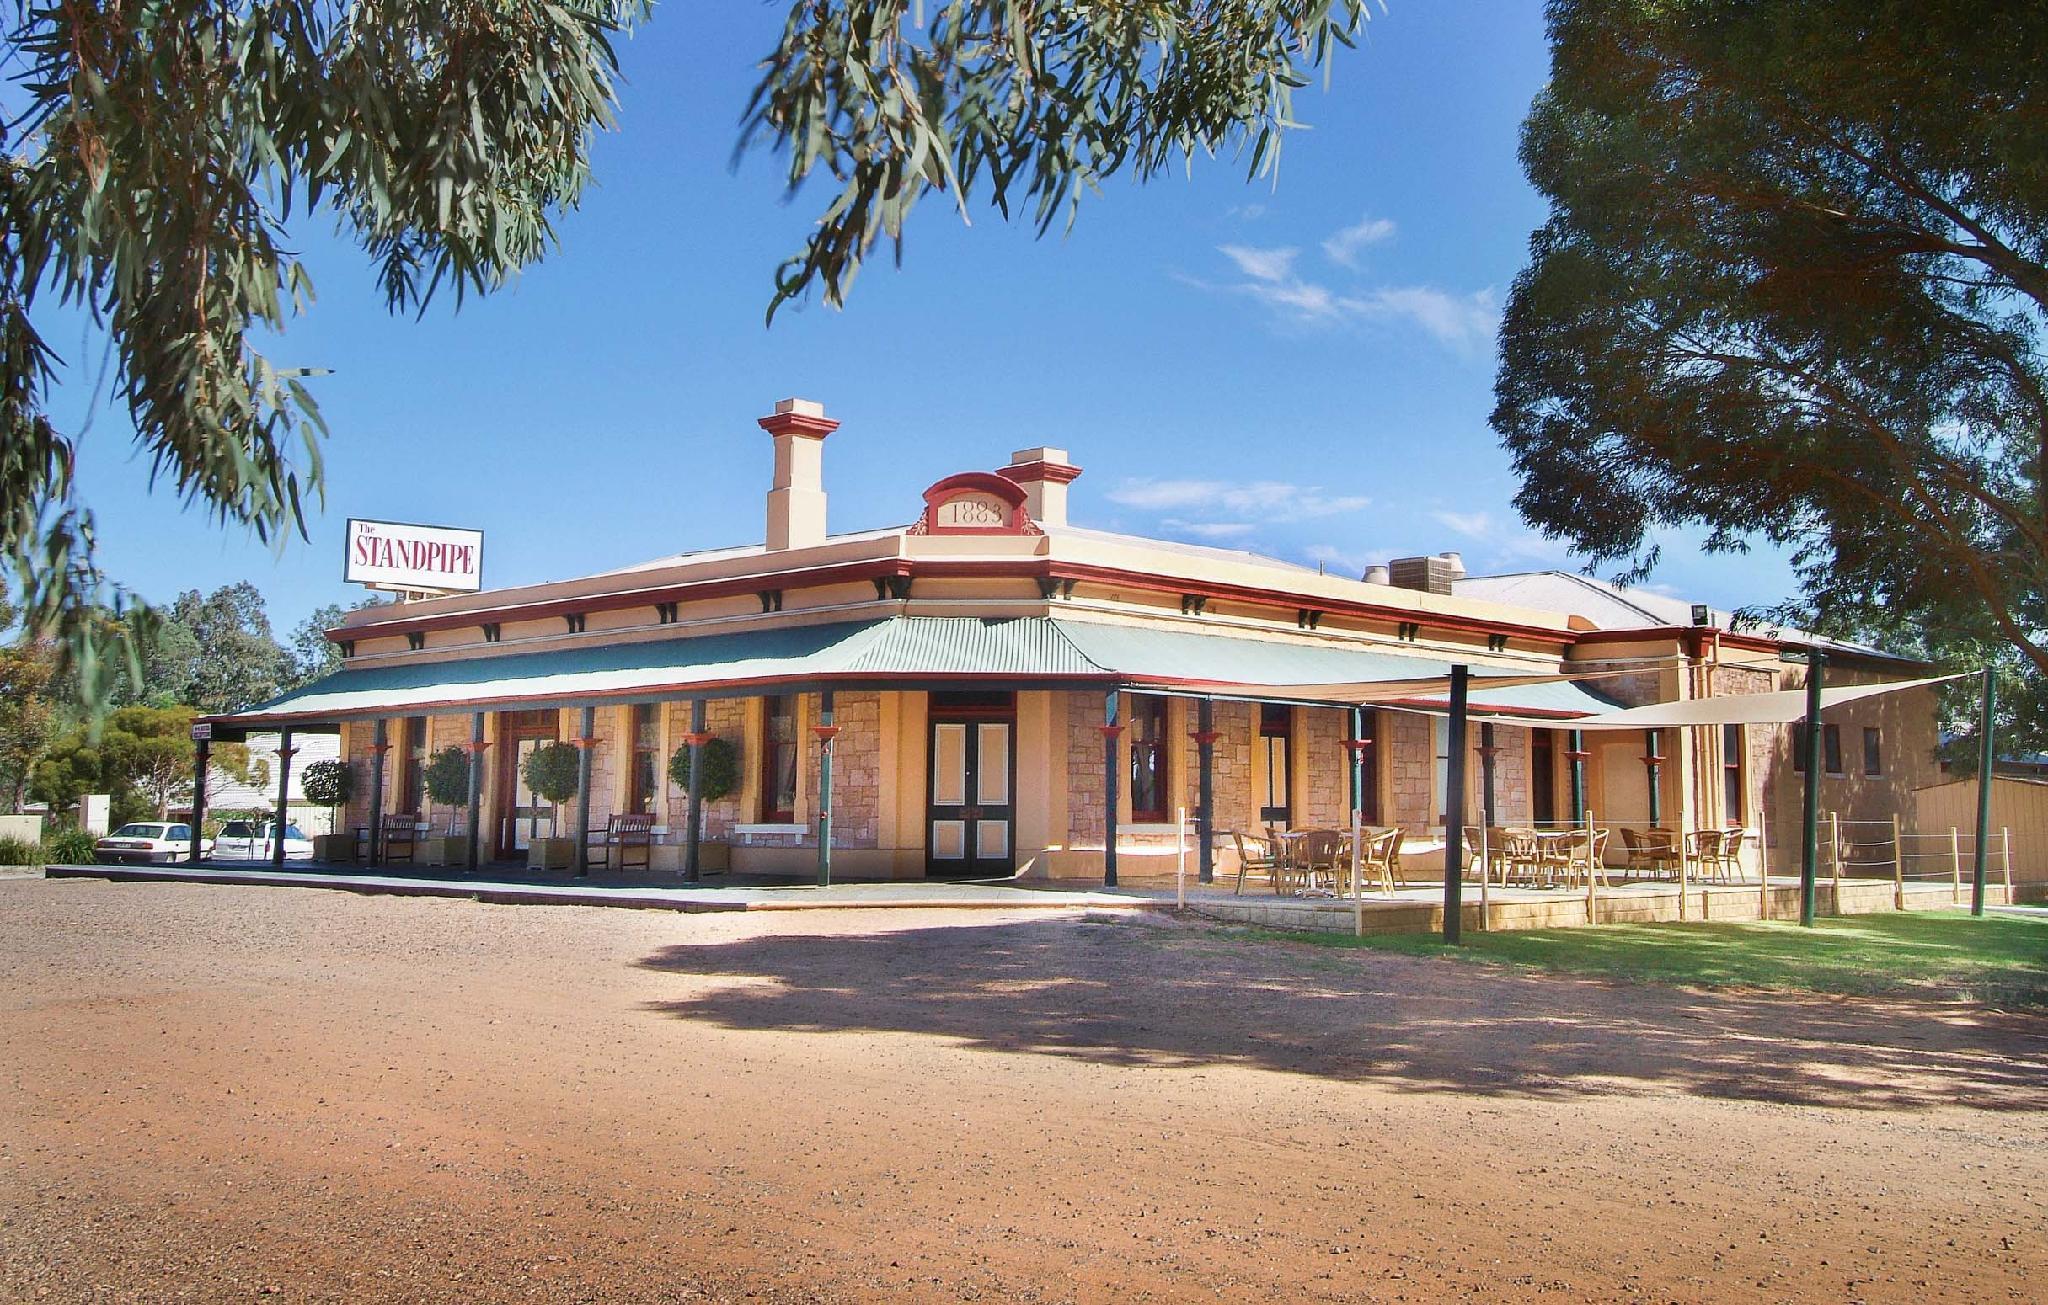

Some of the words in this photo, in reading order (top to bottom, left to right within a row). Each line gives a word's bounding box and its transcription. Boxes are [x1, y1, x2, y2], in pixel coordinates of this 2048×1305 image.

[953, 501, 1002, 523] 1883
[358, 523, 375, 534] The
[355, 534, 474, 574] STANDPIPE
